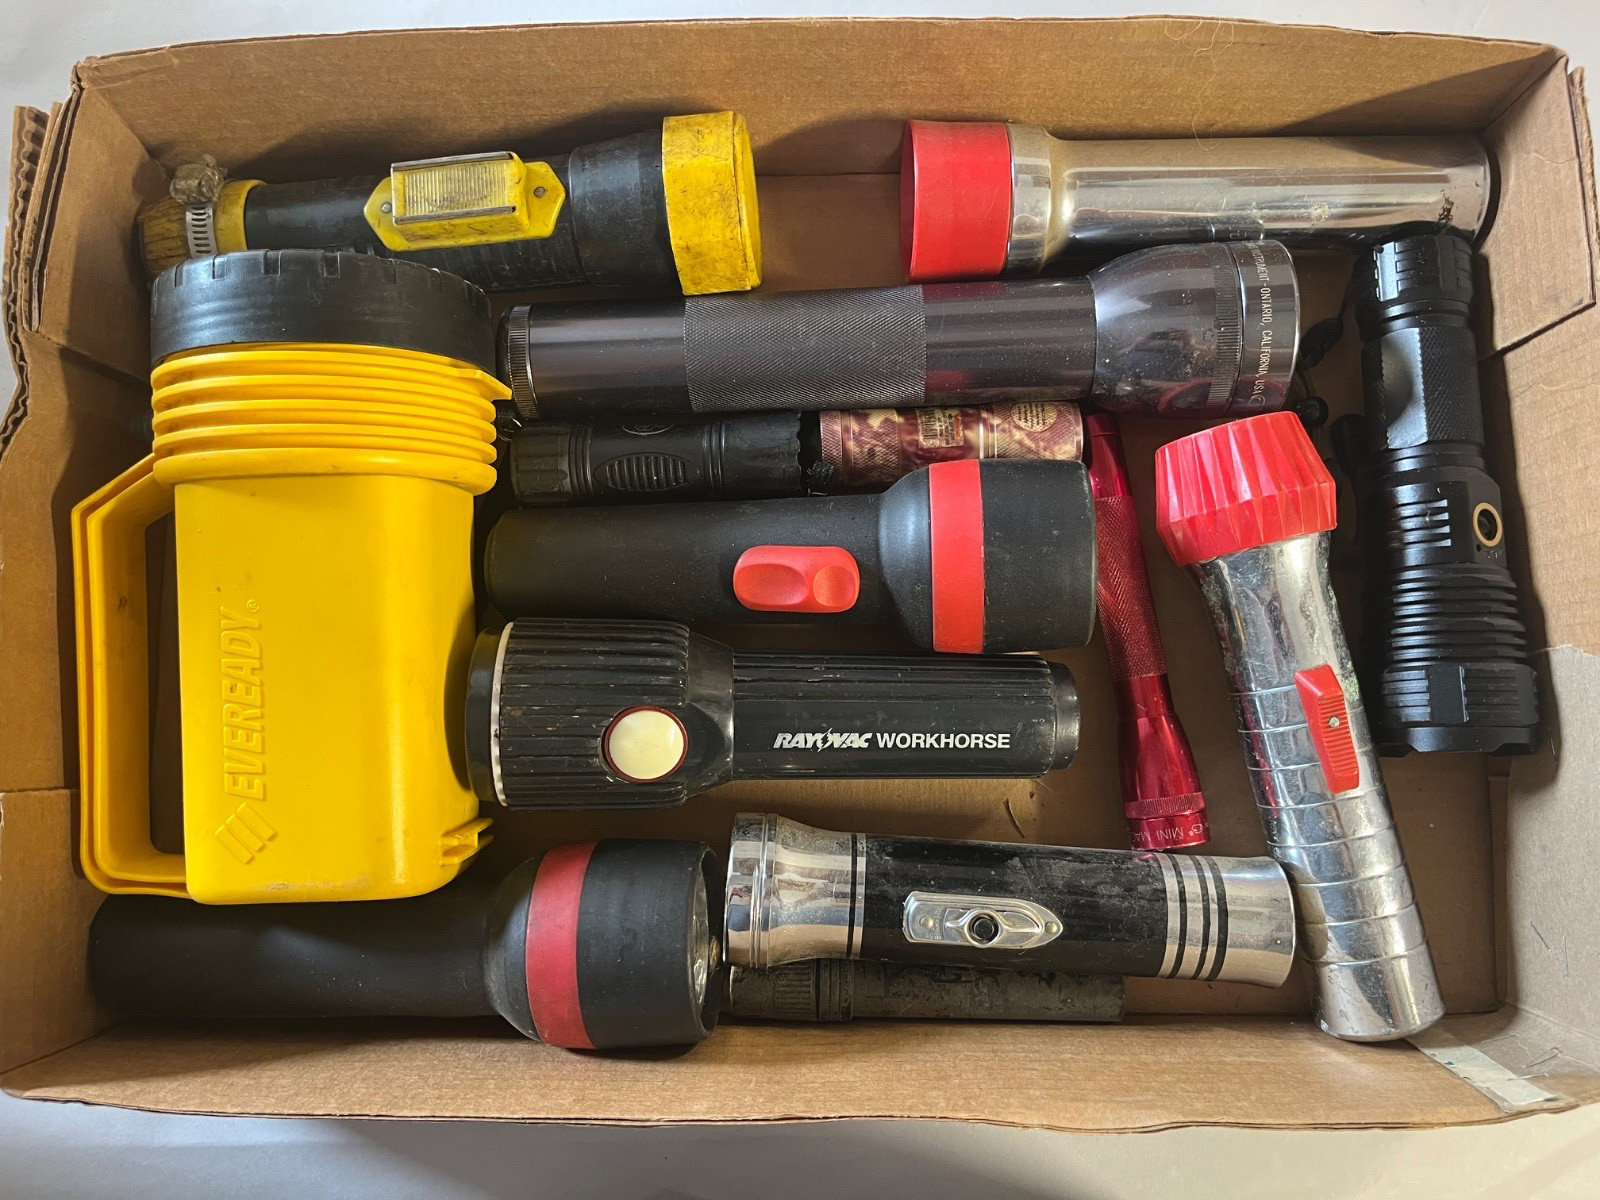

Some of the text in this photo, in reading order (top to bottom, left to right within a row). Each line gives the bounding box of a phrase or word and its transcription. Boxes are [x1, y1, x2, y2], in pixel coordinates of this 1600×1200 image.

[1252, 380, 1265, 395] USA
[773, 728, 1011, 752] RAYOVAC WORKHORSE
[1156, 827, 1185, 841] MINI
